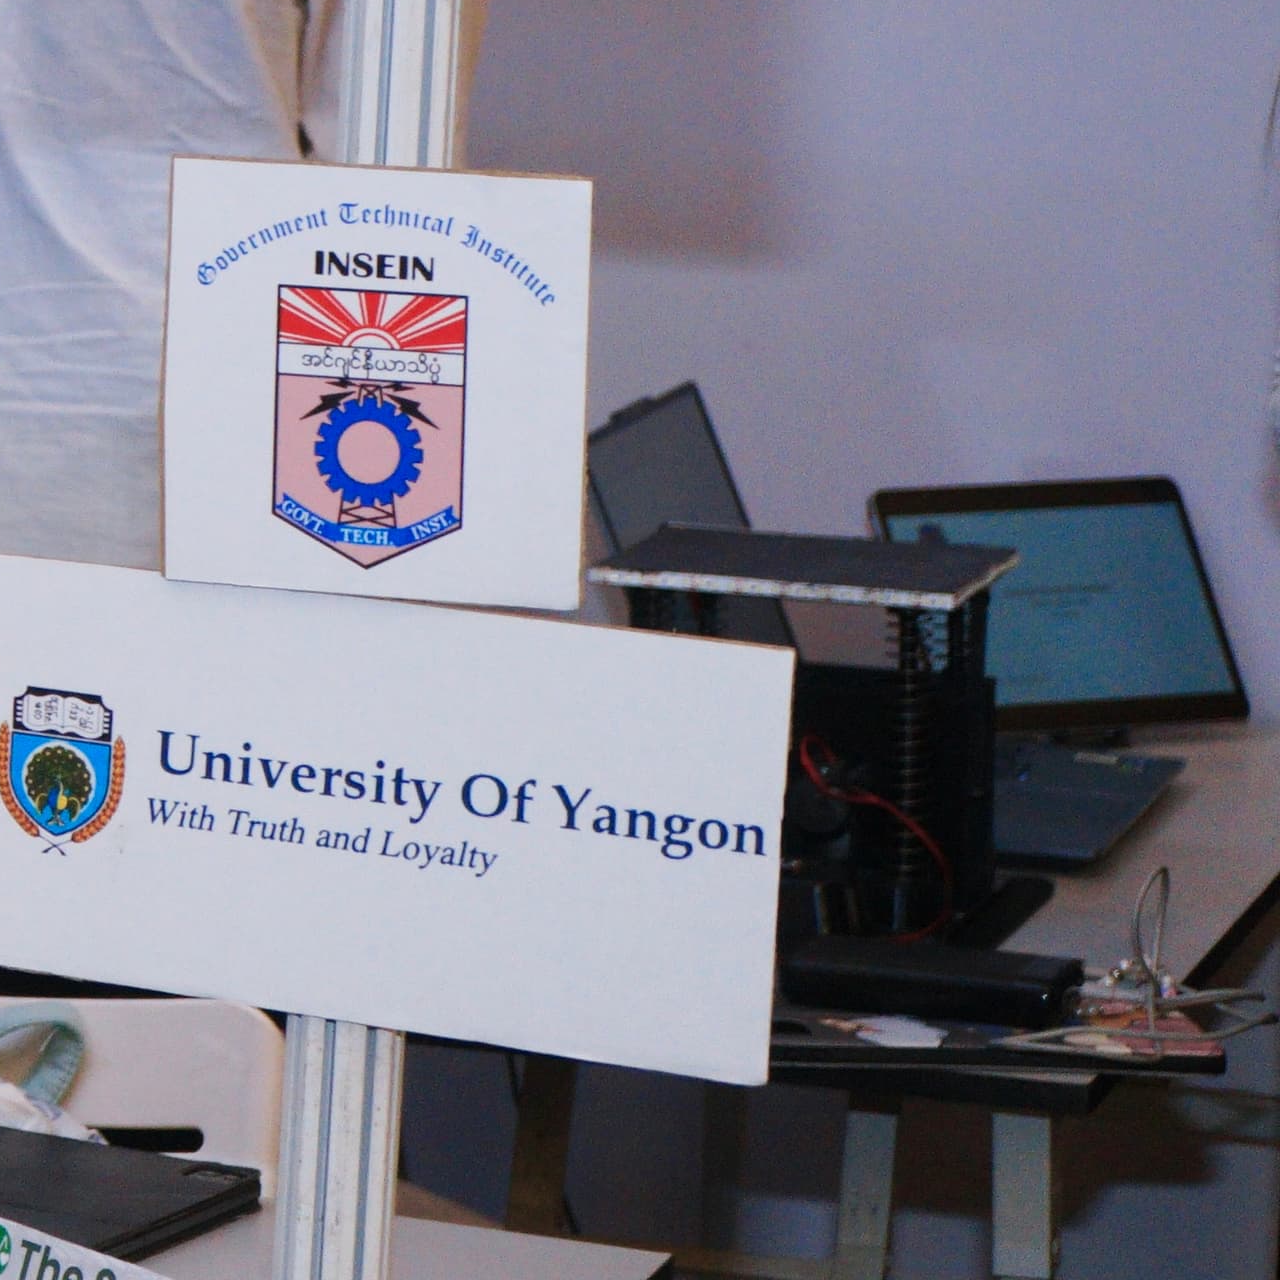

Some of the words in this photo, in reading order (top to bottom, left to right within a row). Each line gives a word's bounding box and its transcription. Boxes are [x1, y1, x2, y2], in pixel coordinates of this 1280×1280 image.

[196, 207, 328, 287] Government
[339, 202, 454, 238] Technical
[460, 224, 557, 308] Institute
[314, 250, 435, 282] INSEIN
[281, 499, 325, 535] GOVT.
[340, 527, 394, 546] TECH.
[410, 510, 453, 541] INST.
[156, 729, 444, 823] University
[461, 771, 538, 824] Of
[553, 784, 767, 860] Yangon
[147, 797, 216, 833] With
[228, 809, 308, 846] Truth
[315, 826, 371, 855] and
[378, 832, 499, 877] Loyalty
